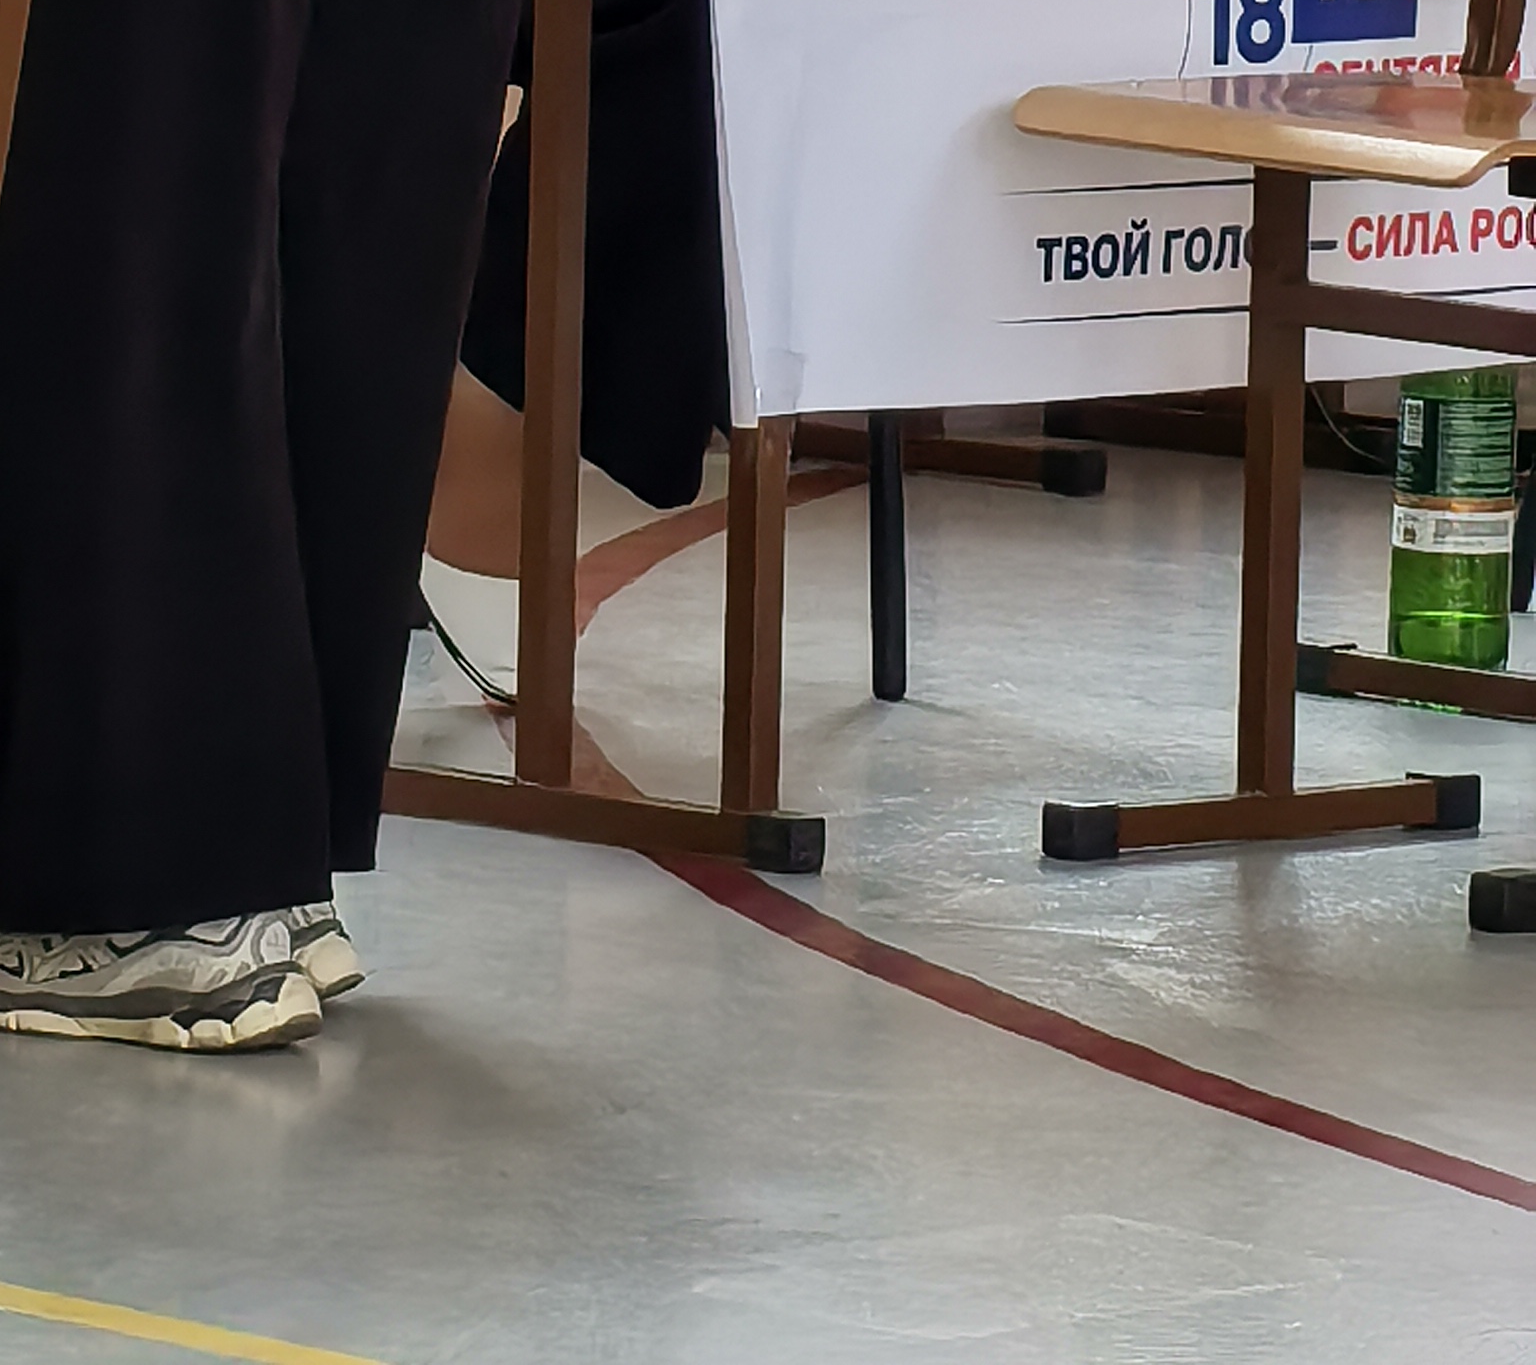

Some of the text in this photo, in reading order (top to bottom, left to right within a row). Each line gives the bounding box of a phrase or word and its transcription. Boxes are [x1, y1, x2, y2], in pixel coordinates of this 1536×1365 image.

[1037, 219, 1150, 282] ТВОЙ
[1163, 225, 1253, 275] ГОЛ
[1348, 211, 1459, 260] СИЛА
